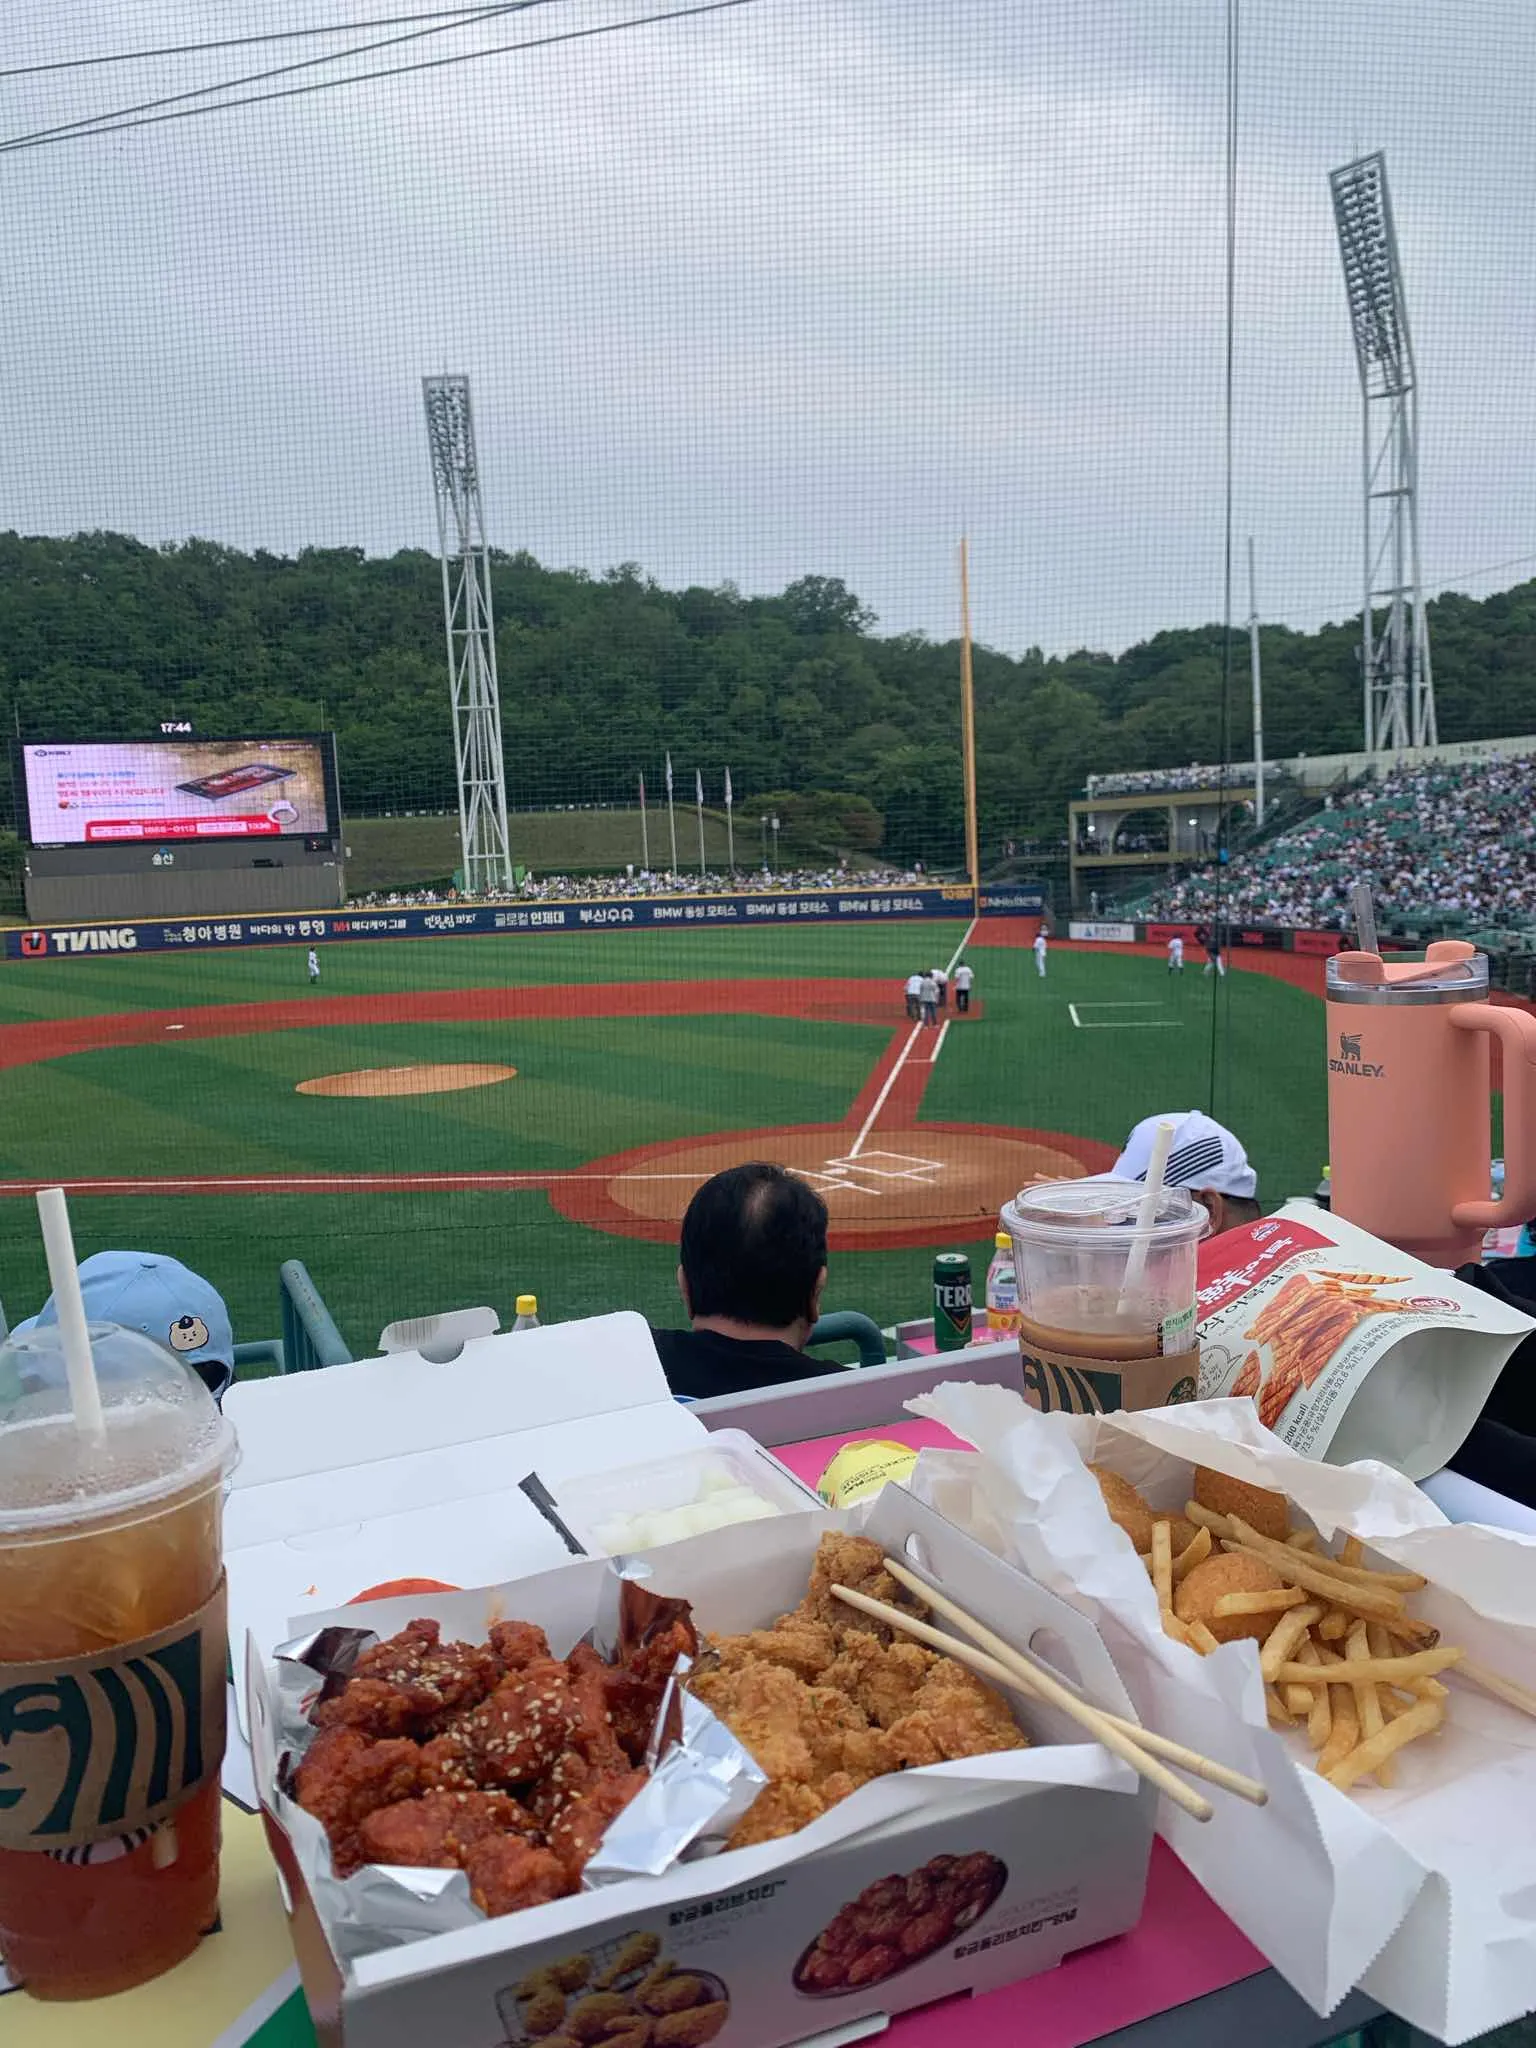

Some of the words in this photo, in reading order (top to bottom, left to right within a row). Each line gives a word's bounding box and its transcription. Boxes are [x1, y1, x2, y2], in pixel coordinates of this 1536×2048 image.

[160, 721, 192, 734] 17:44
[746, 903, 776, 915] BMW
[838, 899, 869, 912] BMW
[579, 908, 635, 924] 부산우유
[653, 907, 682, 919] BMW
[250, 924, 282, 936] 바다의
[299, 920, 326, 937] 통영
[51, 928, 137, 952] TVING
[1328, 1059, 1384, 1078] STANLEY
